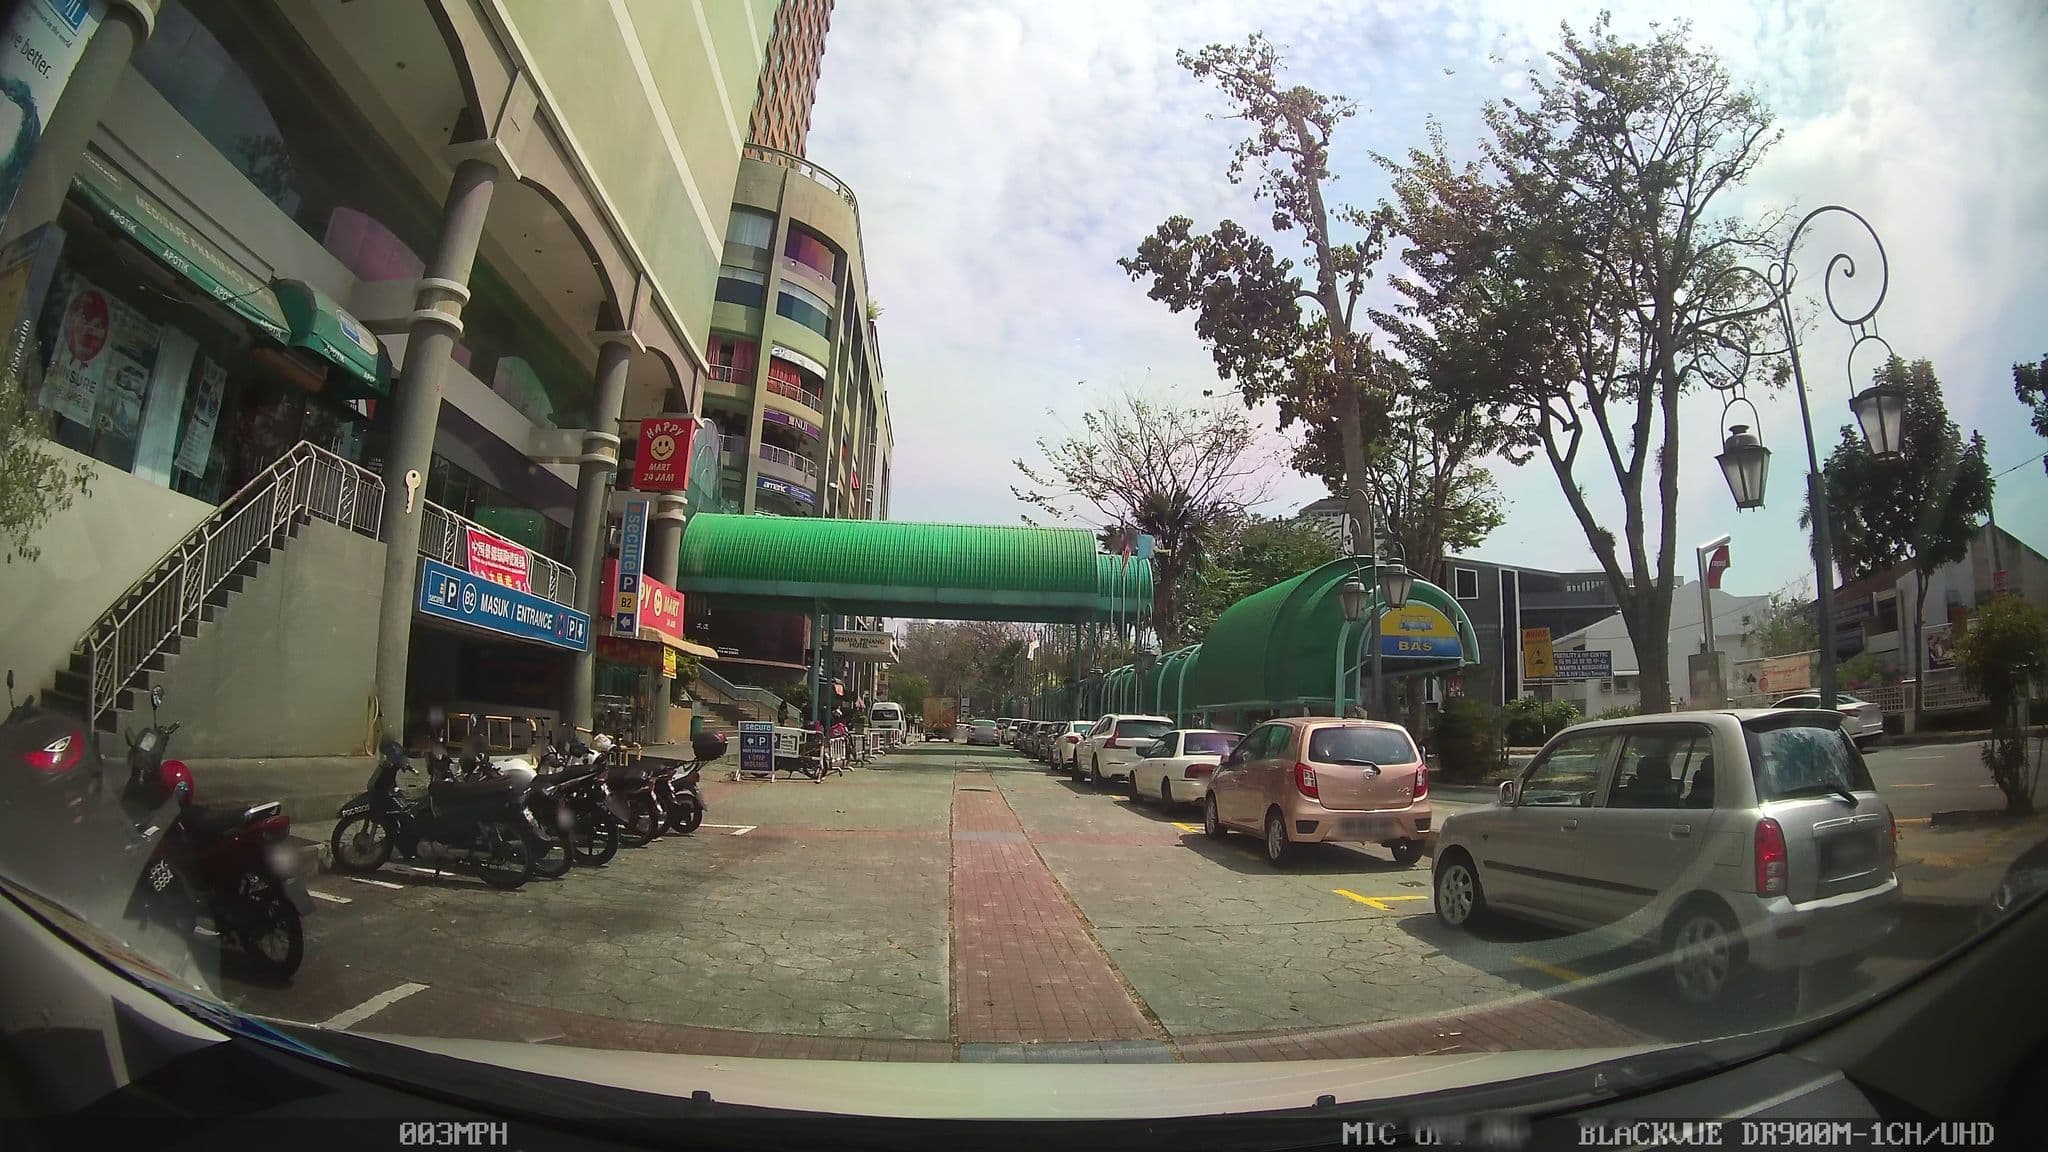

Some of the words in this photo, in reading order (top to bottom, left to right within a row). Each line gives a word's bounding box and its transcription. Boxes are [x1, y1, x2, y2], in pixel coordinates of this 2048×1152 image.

[20, 38, 51, 79] better.
[109, 208, 137, 234] APOTIK
[163, 249, 190, 273] APOTIK
[646, 421, 685, 439] HAPPY
[649, 463, 672, 471] MART
[655, 473, 675, 482] JAM
[623, 514, 640, 570] secure
[623, 576, 634, 590] P
[447, 582, 457, 603] P
[464, 590, 475, 607] B2
[480, 593, 510, 618] MASUK
[511, 603, 516, 621] /
[516, 604, 553, 631] ENTRANCE
[568, 619, 576, 637] P
[621, 597, 632, 608] B2
[663, 595, 680, 617] MART
[1398, 641, 1433, 652] BAS
[745, 723, 771, 731] secure
[759, 736, 766, 746] P
